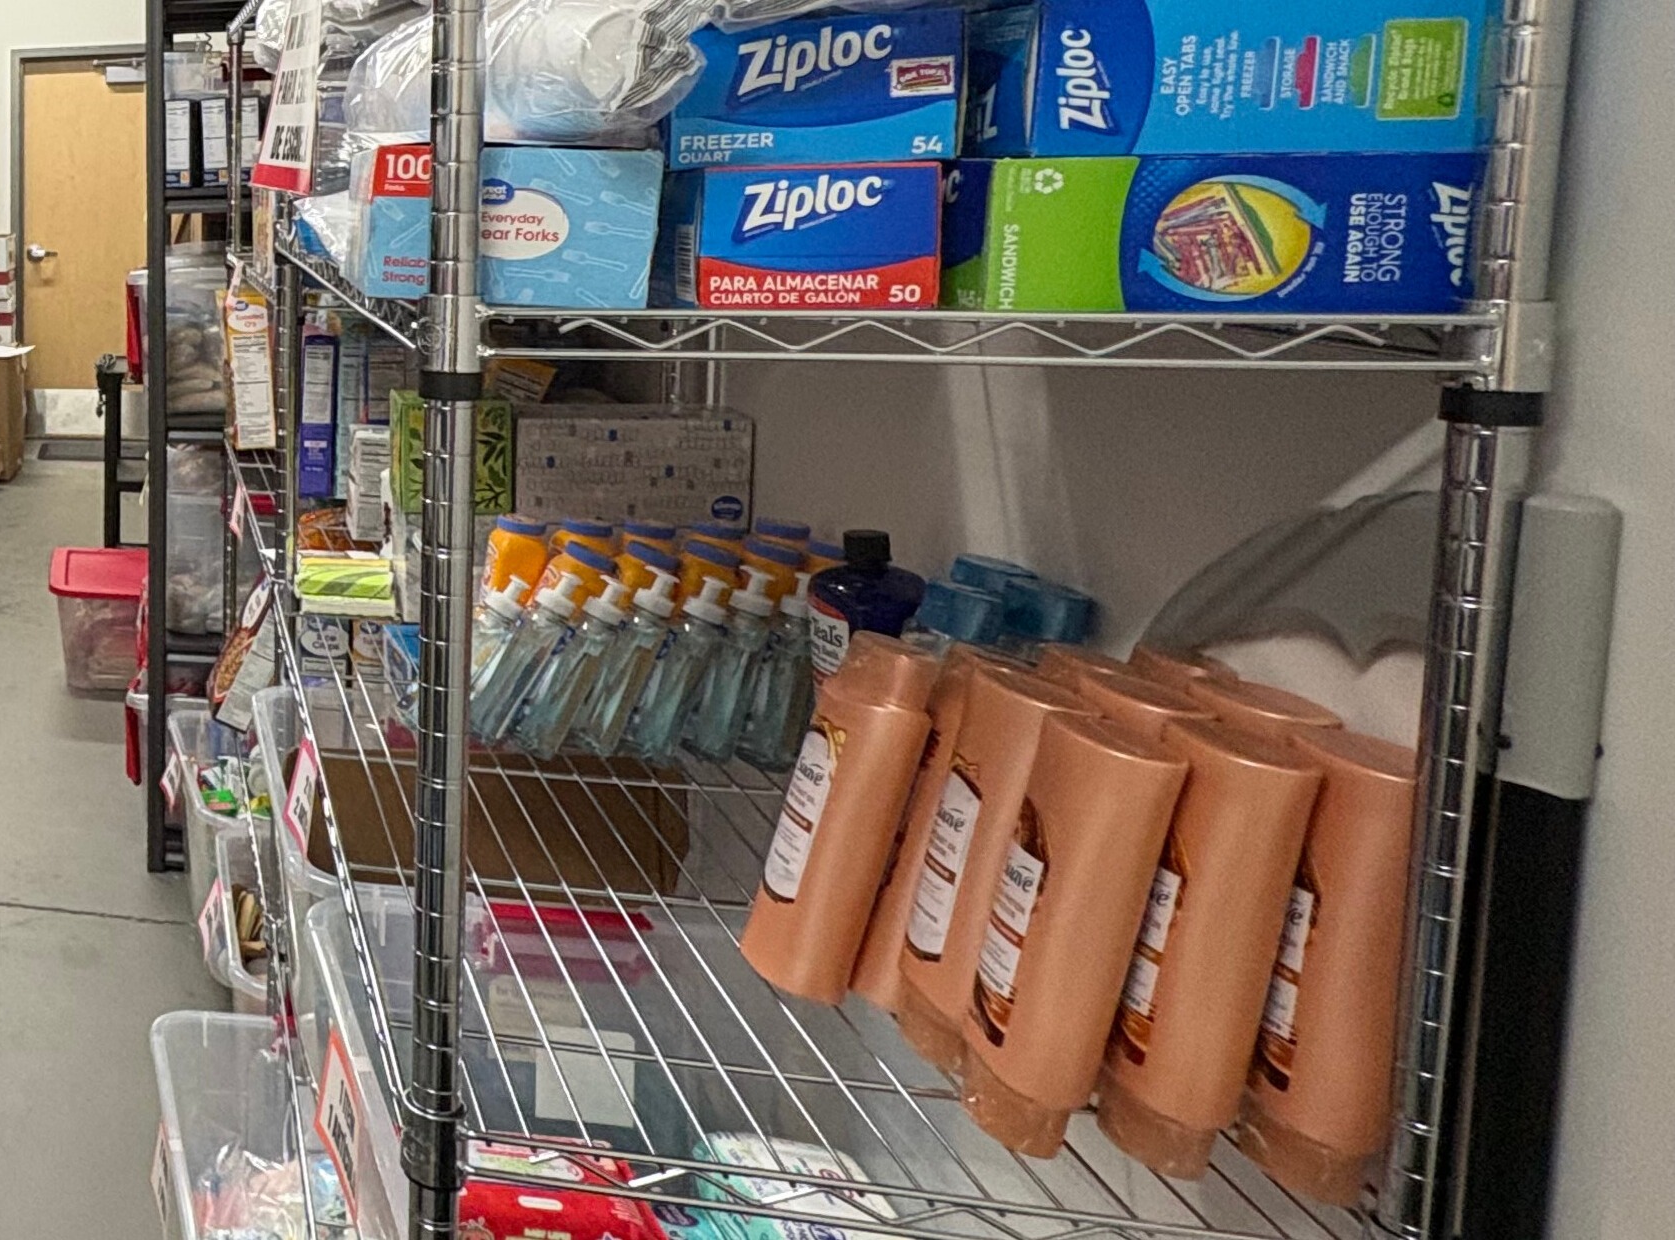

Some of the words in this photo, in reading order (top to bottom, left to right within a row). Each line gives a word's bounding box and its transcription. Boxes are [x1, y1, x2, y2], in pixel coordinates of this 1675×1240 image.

[737, 24, 893, 96] Ziploc
[1180, 35, 1196, 71] TABS
[1337, 39, 1350, 76] SNACK
[1056, 28, 1111, 131] Ziploc
[1160, 57, 1177, 94] EASY
[1240, 51, 1256, 98] FREEZER
[1280, 48, 1296, 98] STORAGE
[1321, 42, 1338, 103] SANDWICH
[1175, 75, 1193, 116] OPEN
[1333, 80, 1346, 104] AND
[678, 151, 733, 165] QUART
[679, 132, 774, 151] FREEZER
[911, 135, 943, 154] 54
[386, 154, 431, 179] 100
[481, 211, 544, 226] Everyday
[742, 174, 885, 232] Ziploc
[1348, 193, 1367, 226] USE
[481, 229, 511, 240] ear
[515, 228, 560, 242] Forks
[1364, 193, 1384, 258] ENOUGH
[1377, 193, 1407, 283] STRONG
[384, 256, 429, 269] Reliab
[999, 224, 1020, 310] SANDWICH
[1343, 230, 1365, 284] AGAIN
[1361, 262, 1377, 283] TO
[382, 270, 426, 287] Strong
[709, 276, 761, 291] PARA
[764, 274, 880, 291] ALMACENAR
[889, 285, 922, 303] 50
[710, 291, 776, 305] CUARTO
[779, 291, 800, 304] DE
[804, 288, 861, 304] GALÓN
[1005, 865, 1035, 893] uave
